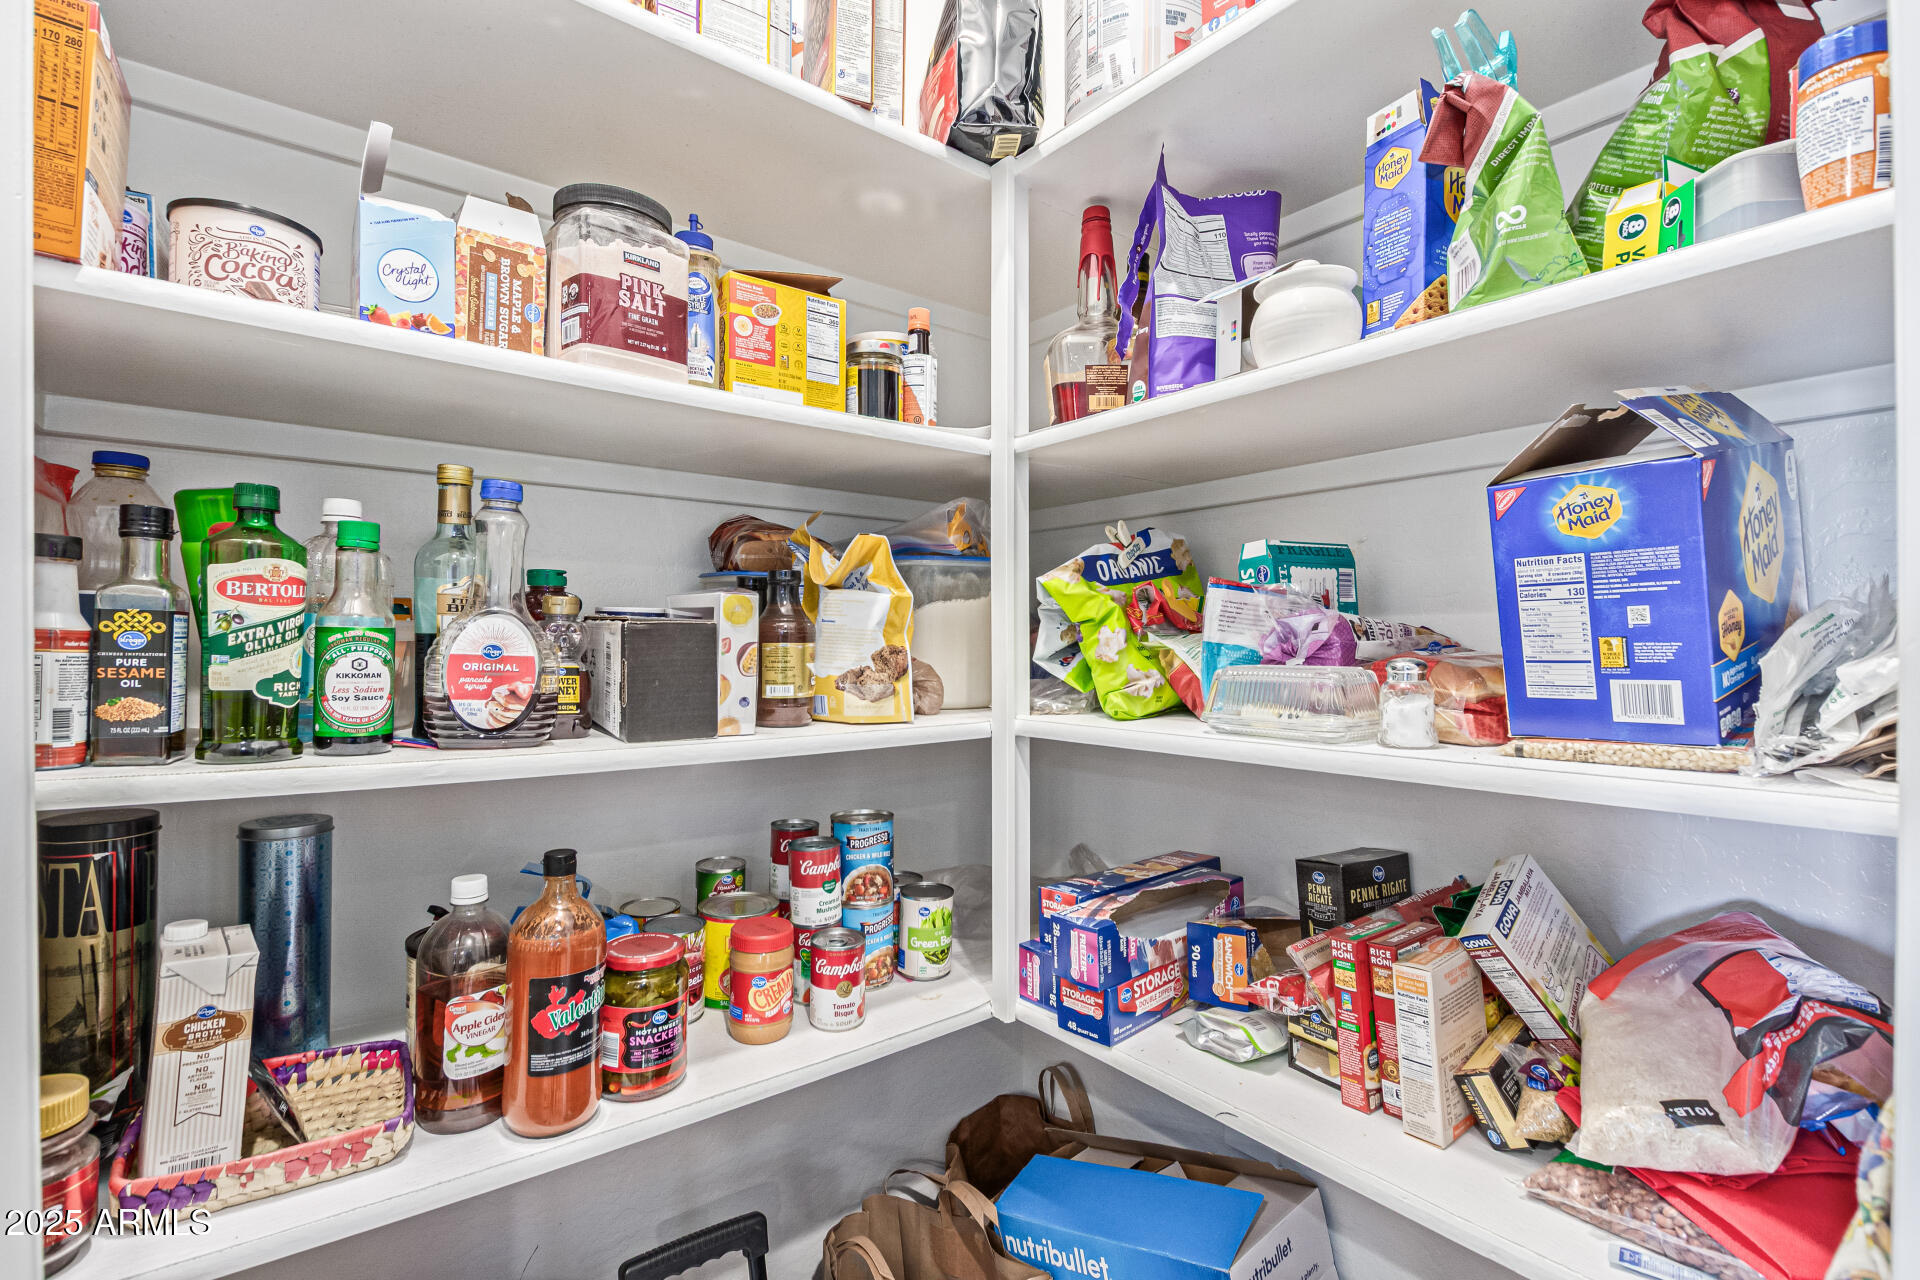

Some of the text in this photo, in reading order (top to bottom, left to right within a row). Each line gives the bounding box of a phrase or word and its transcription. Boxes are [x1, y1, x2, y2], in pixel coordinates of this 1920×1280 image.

[42, 28, 60, 40] 170
[65, 35, 82, 48] 280
[1489, 111, 1542, 168] DIRECT IMPAC
[1376, 152, 1409, 176] Honey
[1379, 165, 1404, 184] Maid
[1213, 231, 1227, 240] 110
[222, 240, 292, 273] Baking
[624, 252, 660, 269] KIRKLAND
[204, 253, 299, 292] Cocoa
[382, 262, 427, 283] Crystal
[619, 273, 664, 300] PINK
[498, 257, 511, 349] BROWN SUGAR
[511, 279, 522, 334] MAPLE &
[618, 289, 667, 318] SALT
[628, 312, 659, 326] FINE GRAIN
[1556, 492, 1615, 521] Honey
[1567, 507, 1611, 532] Maid
[1743, 489, 1779, 549] Honey
[1276, 544, 1345, 558] FRAGILE
[1752, 530, 1780, 582] Maid
[1516, 555, 1583, 568] Nutrition Facts
[225, 580, 306, 598] BERTOLL
[1519, 587, 1585, 599] Calories 130
[227, 613, 304, 646] EXTRA VIRGI
[1721, 620, 1742, 638] Honey
[120, 634, 146, 647] Kroger
[245, 628, 299, 652] OLIVE OIL
[115, 658, 148, 667] PURE
[462, 662, 520, 672] ORIGINAL
[96, 667, 166, 679] SESAME
[458, 676, 493, 684] pancake
[120, 679, 142, 688] OIL
[331, 685, 385, 694] Less Sodium
[463, 683, 488, 691] syrup
[331, 694, 350, 703] Soy
[850, 832, 889, 848] PROGRESSO
[1307, 883, 1332, 896] PENNE
[1350, 878, 1408, 904] PENNE RIGATE
[1492, 880, 1512, 905] GOYA
[1516, 868, 1535, 904] JAMBALAYA
[1524, 885, 1533, 898] MIX
[818, 896, 834, 907] Cream
[1307, 893, 1333, 906] RIGATE
[1474, 872, 1502, 919] JAMBALAYA
[1499, 904, 1520, 937] GOYA
[1053, 922, 1060, 937] 28
[1250, 931, 1256, 943] 90
[910, 937, 939, 948] Green
[1331, 939, 1353, 952] RICE
[1463, 938, 1493, 950] GOYA
[1079, 933, 1087, 970] FREEZER
[1191, 944, 1201, 961] 90
[1369, 947, 1392, 959] RICE
[1224, 936, 1234, 990] SANDWICH
[1133, 962, 1181, 999] STORAGE
[1050, 993, 1057, 1007] 28
[1062, 987, 1095, 1006] STORAGE
[832, 1001, 856, 1011] Tomato
[1569, 981, 1582, 1029] JAMBALAYA
[834, 1009, 855, 1018] Bisque
[183, 1017, 226, 1034] CHICKEN
[452, 1011, 506, 1034] Apple Cider
[635, 1028, 652, 1036] HOT
[658, 1019, 680, 1032] SWEET
[835, 1019, 854, 1027] SOUP
[1067, 1021, 1077, 1031] 48
[1077, 1027, 1089, 1036] QUART
[1310, 1021, 1332, 1036] SPAGHETTI
[188, 1028, 223, 1040] BROTH
[465, 1025, 497, 1040] VINEGAR
[629, 1023, 683, 1047] SNACKERS
[1113, 1027, 1120, 1036] 48
[197, 1052, 210, 1060] NO
[195, 1065, 209, 1074] NO
[194, 1082, 208, 1091] NO
[1668, 1106, 1715, 1118] 10 LB.
[1004, 1233, 1109, 1280] nutribullet
